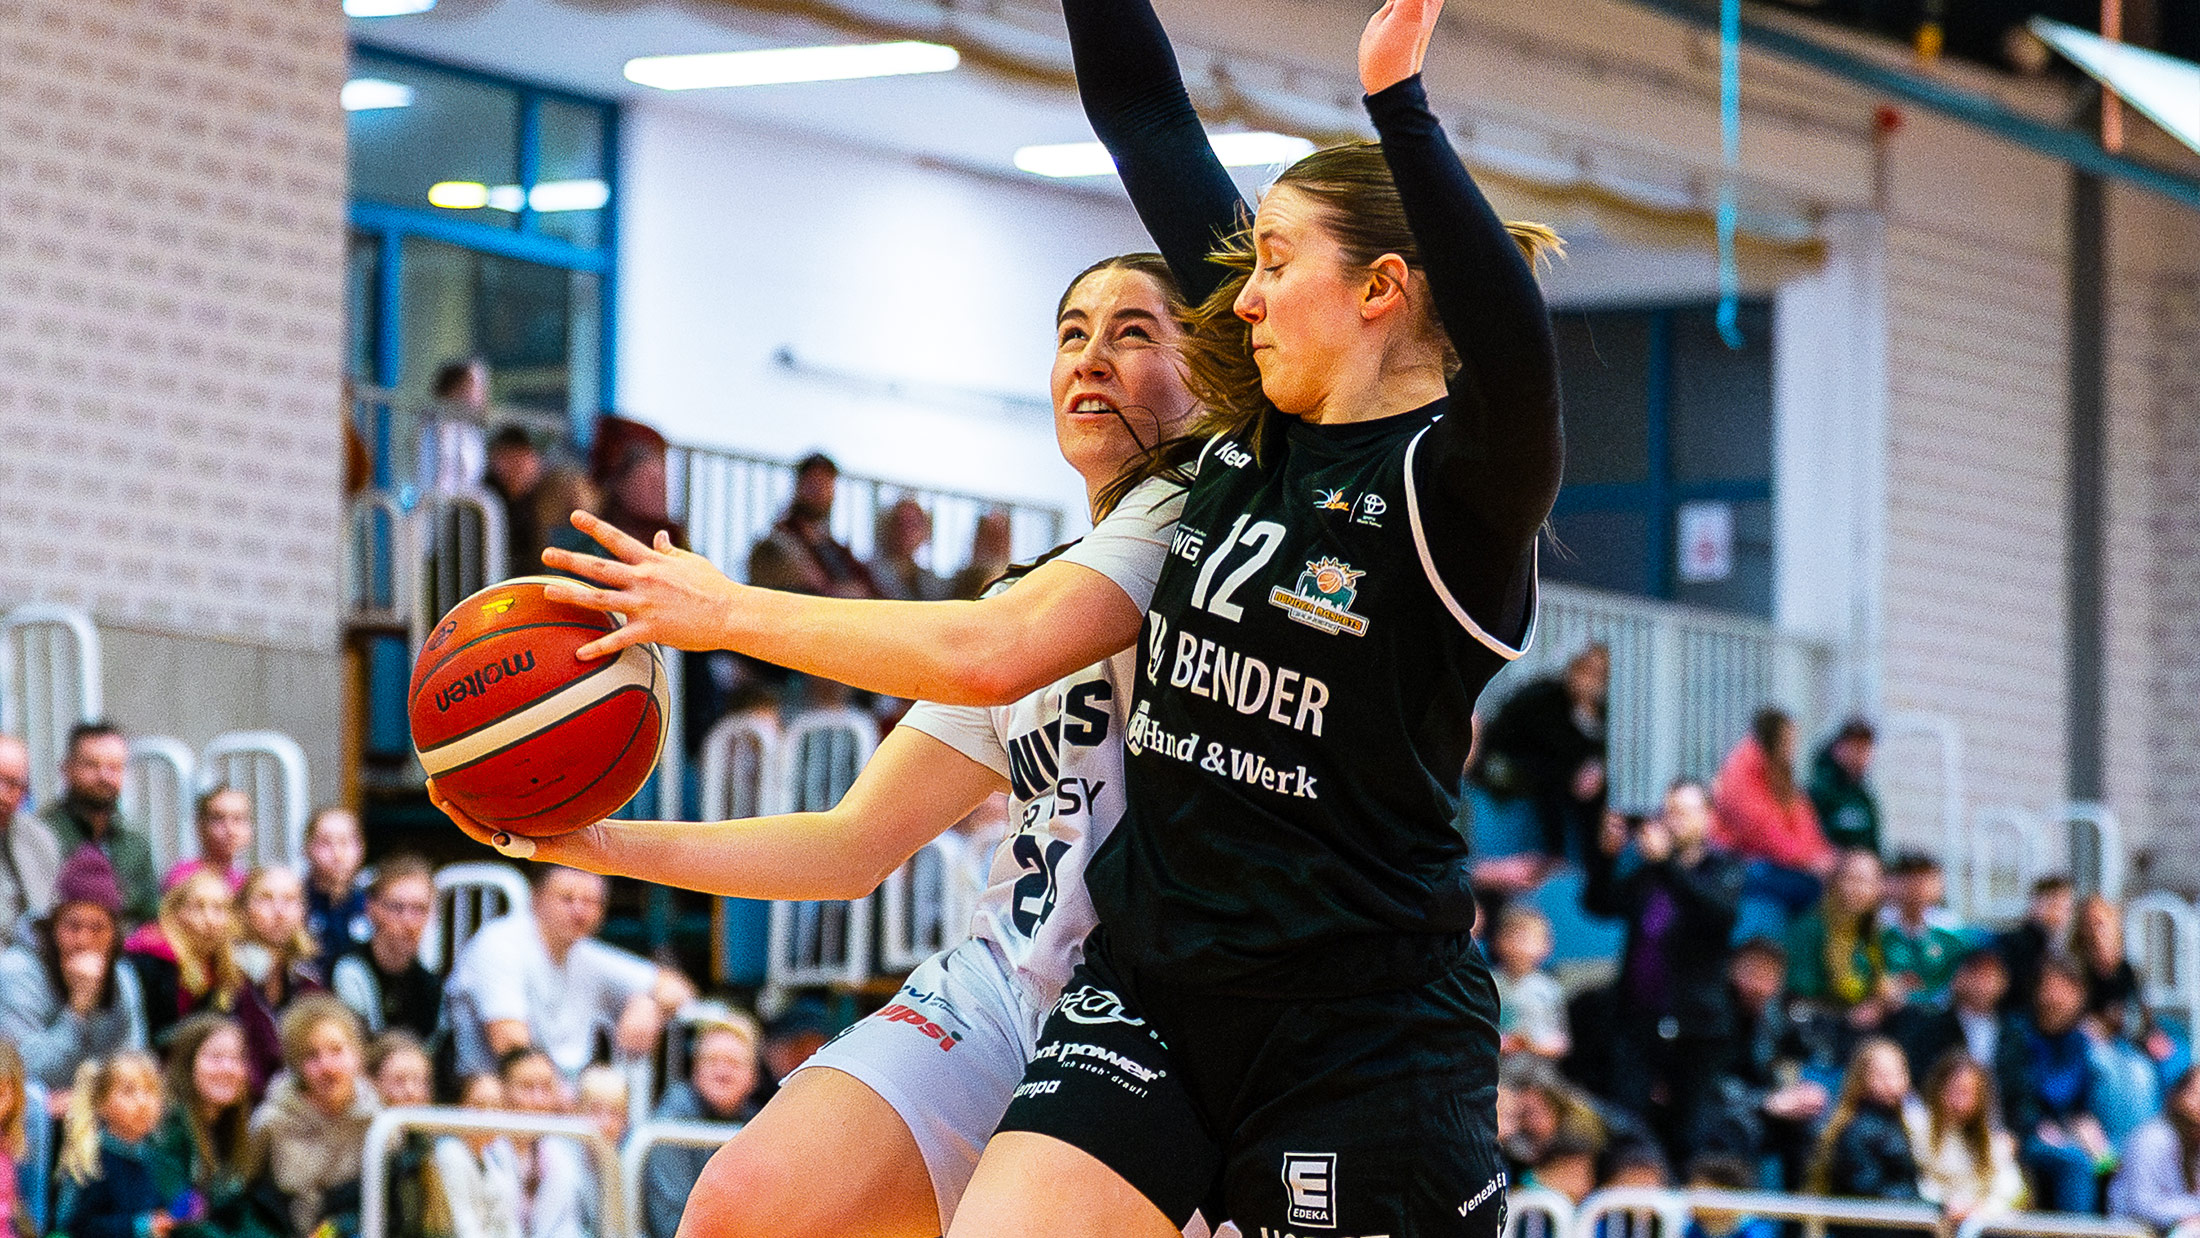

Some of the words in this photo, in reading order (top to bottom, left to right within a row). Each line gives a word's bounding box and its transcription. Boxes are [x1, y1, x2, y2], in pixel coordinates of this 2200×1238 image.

[1190, 513, 1287, 623] 12
[434, 649, 536, 712] molten
[1170, 630, 1330, 737] BENDER
[1143, 718, 1200, 762] Hand
[1230, 748, 1318, 799] Werk
[1293, 1207, 1329, 1220] EDEKA
